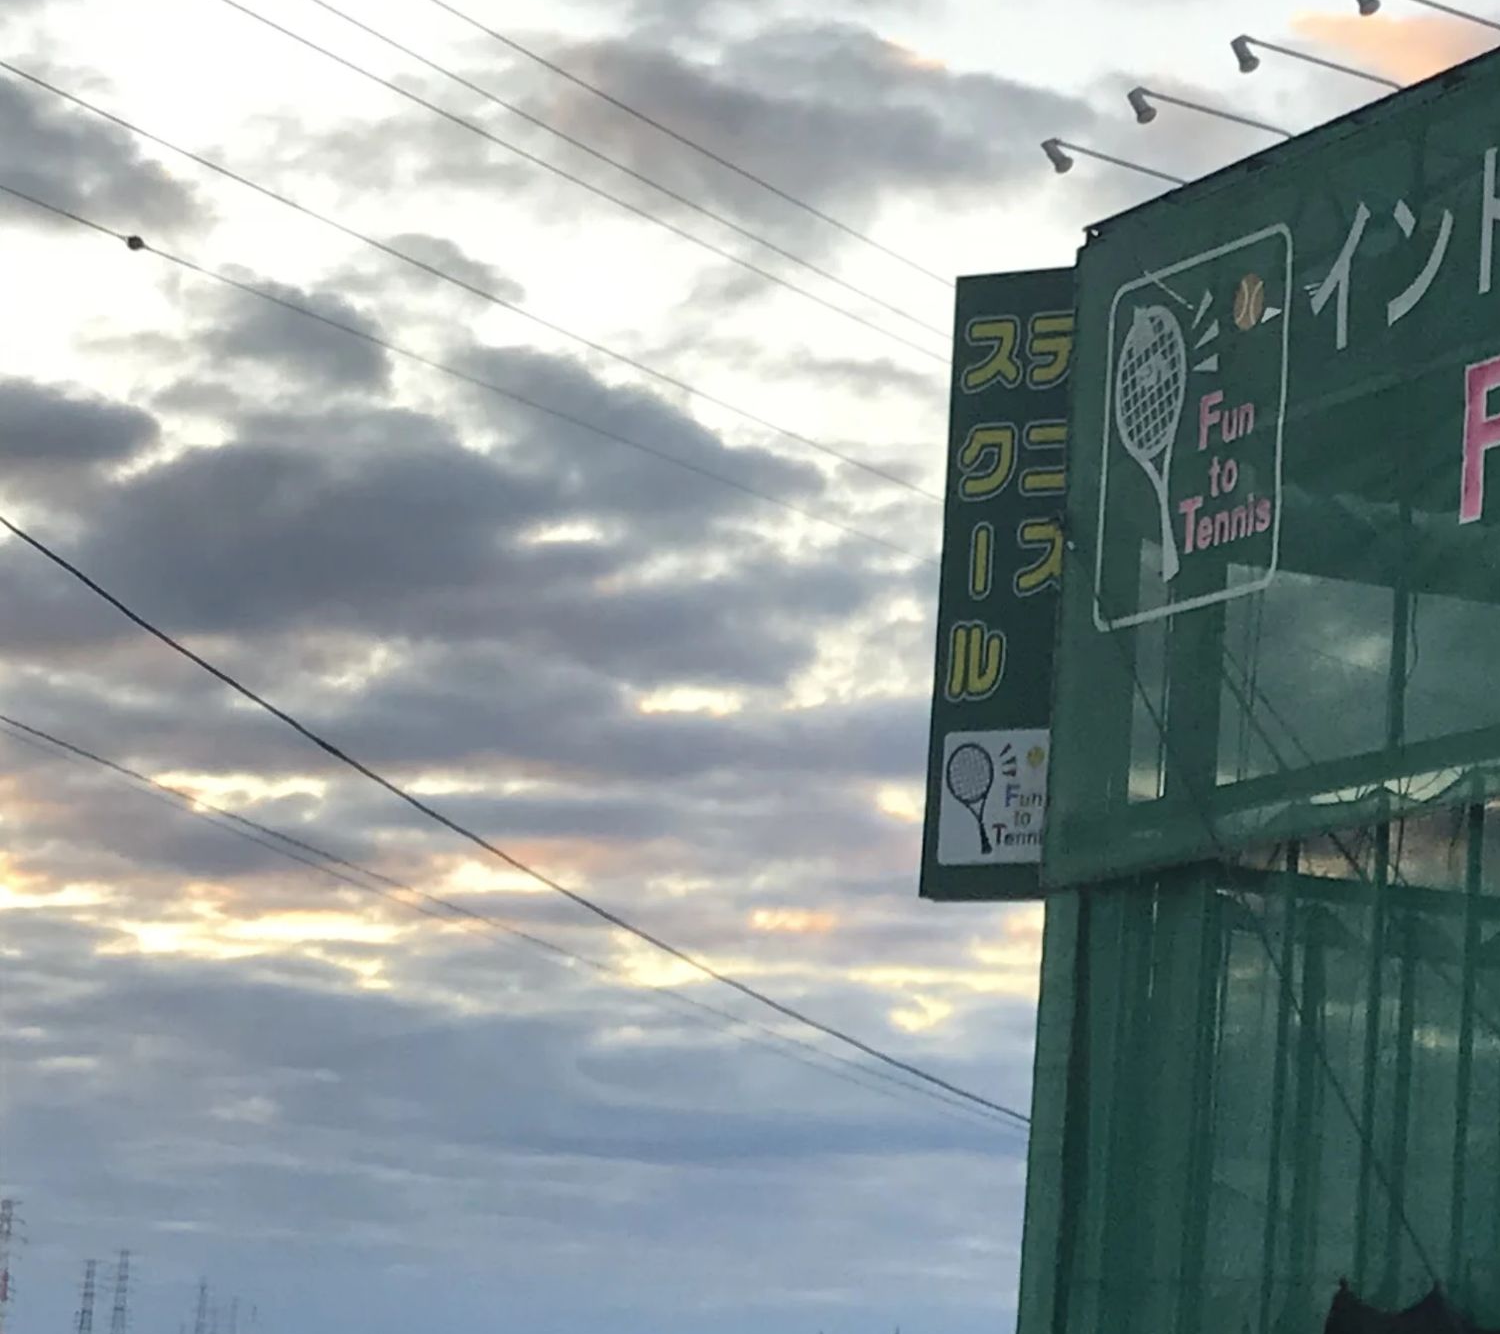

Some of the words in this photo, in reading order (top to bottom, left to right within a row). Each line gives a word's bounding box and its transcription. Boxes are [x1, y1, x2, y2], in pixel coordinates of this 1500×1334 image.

[1198, 390, 1255, 451] Fun
[1209, 455, 1238, 498] to
[945, 314, 1022, 703] スクール
[1178, 492, 1272, 555] Tennis
[1004, 783, 1043, 808] Fun
[992, 823, 1044, 846] Tenni
